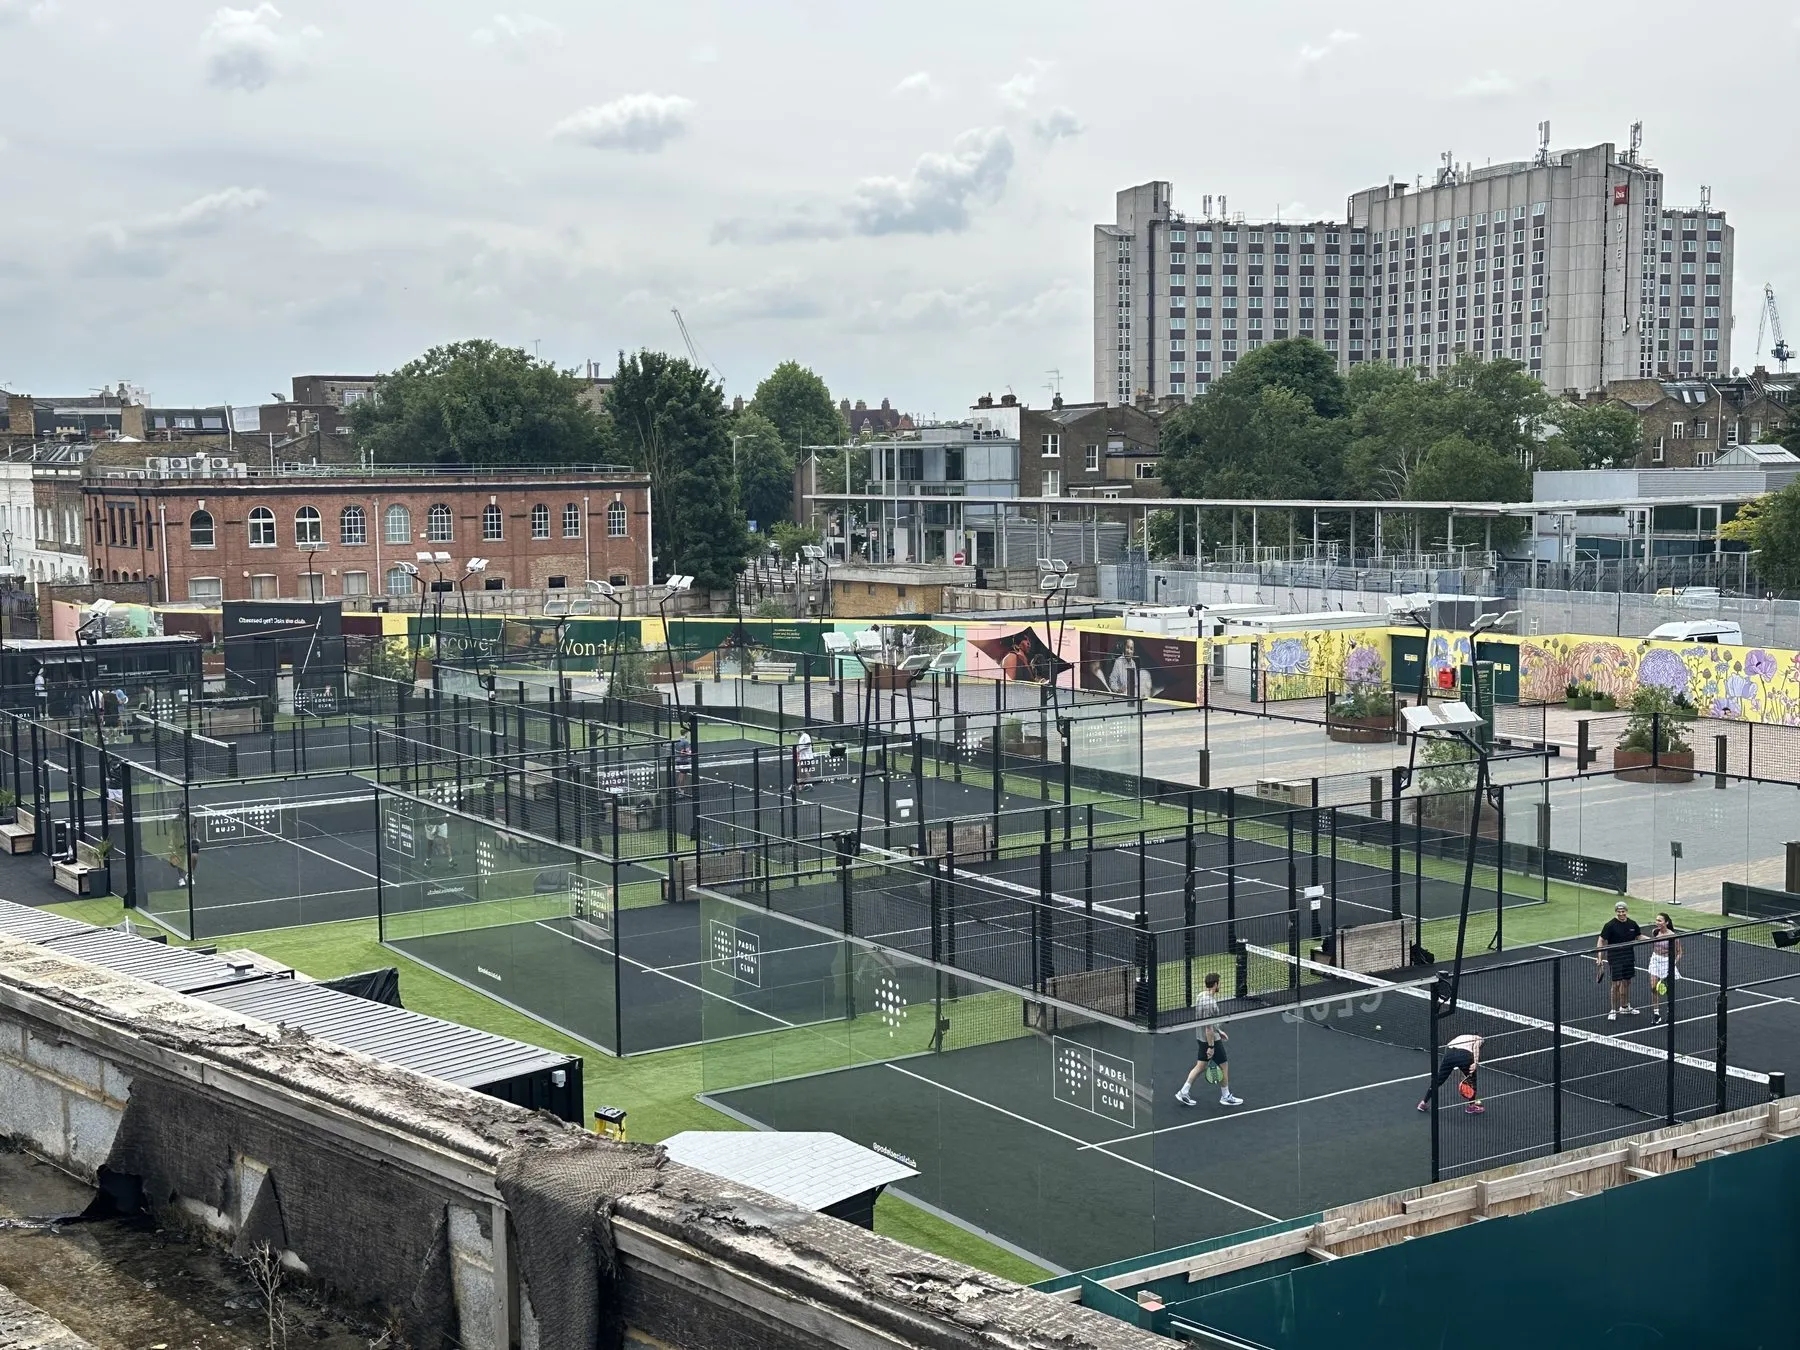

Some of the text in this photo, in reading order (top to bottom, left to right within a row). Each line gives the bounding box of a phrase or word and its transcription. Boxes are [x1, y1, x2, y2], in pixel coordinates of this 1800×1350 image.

[738, 939, 756, 952] PADEL
[740, 963, 754, 974] CLUB
[1099, 1064, 1127, 1082] PADEL
[1097, 1078, 1130, 1098] SOCIAL
[1102, 1095, 1124, 1110] CLUB
